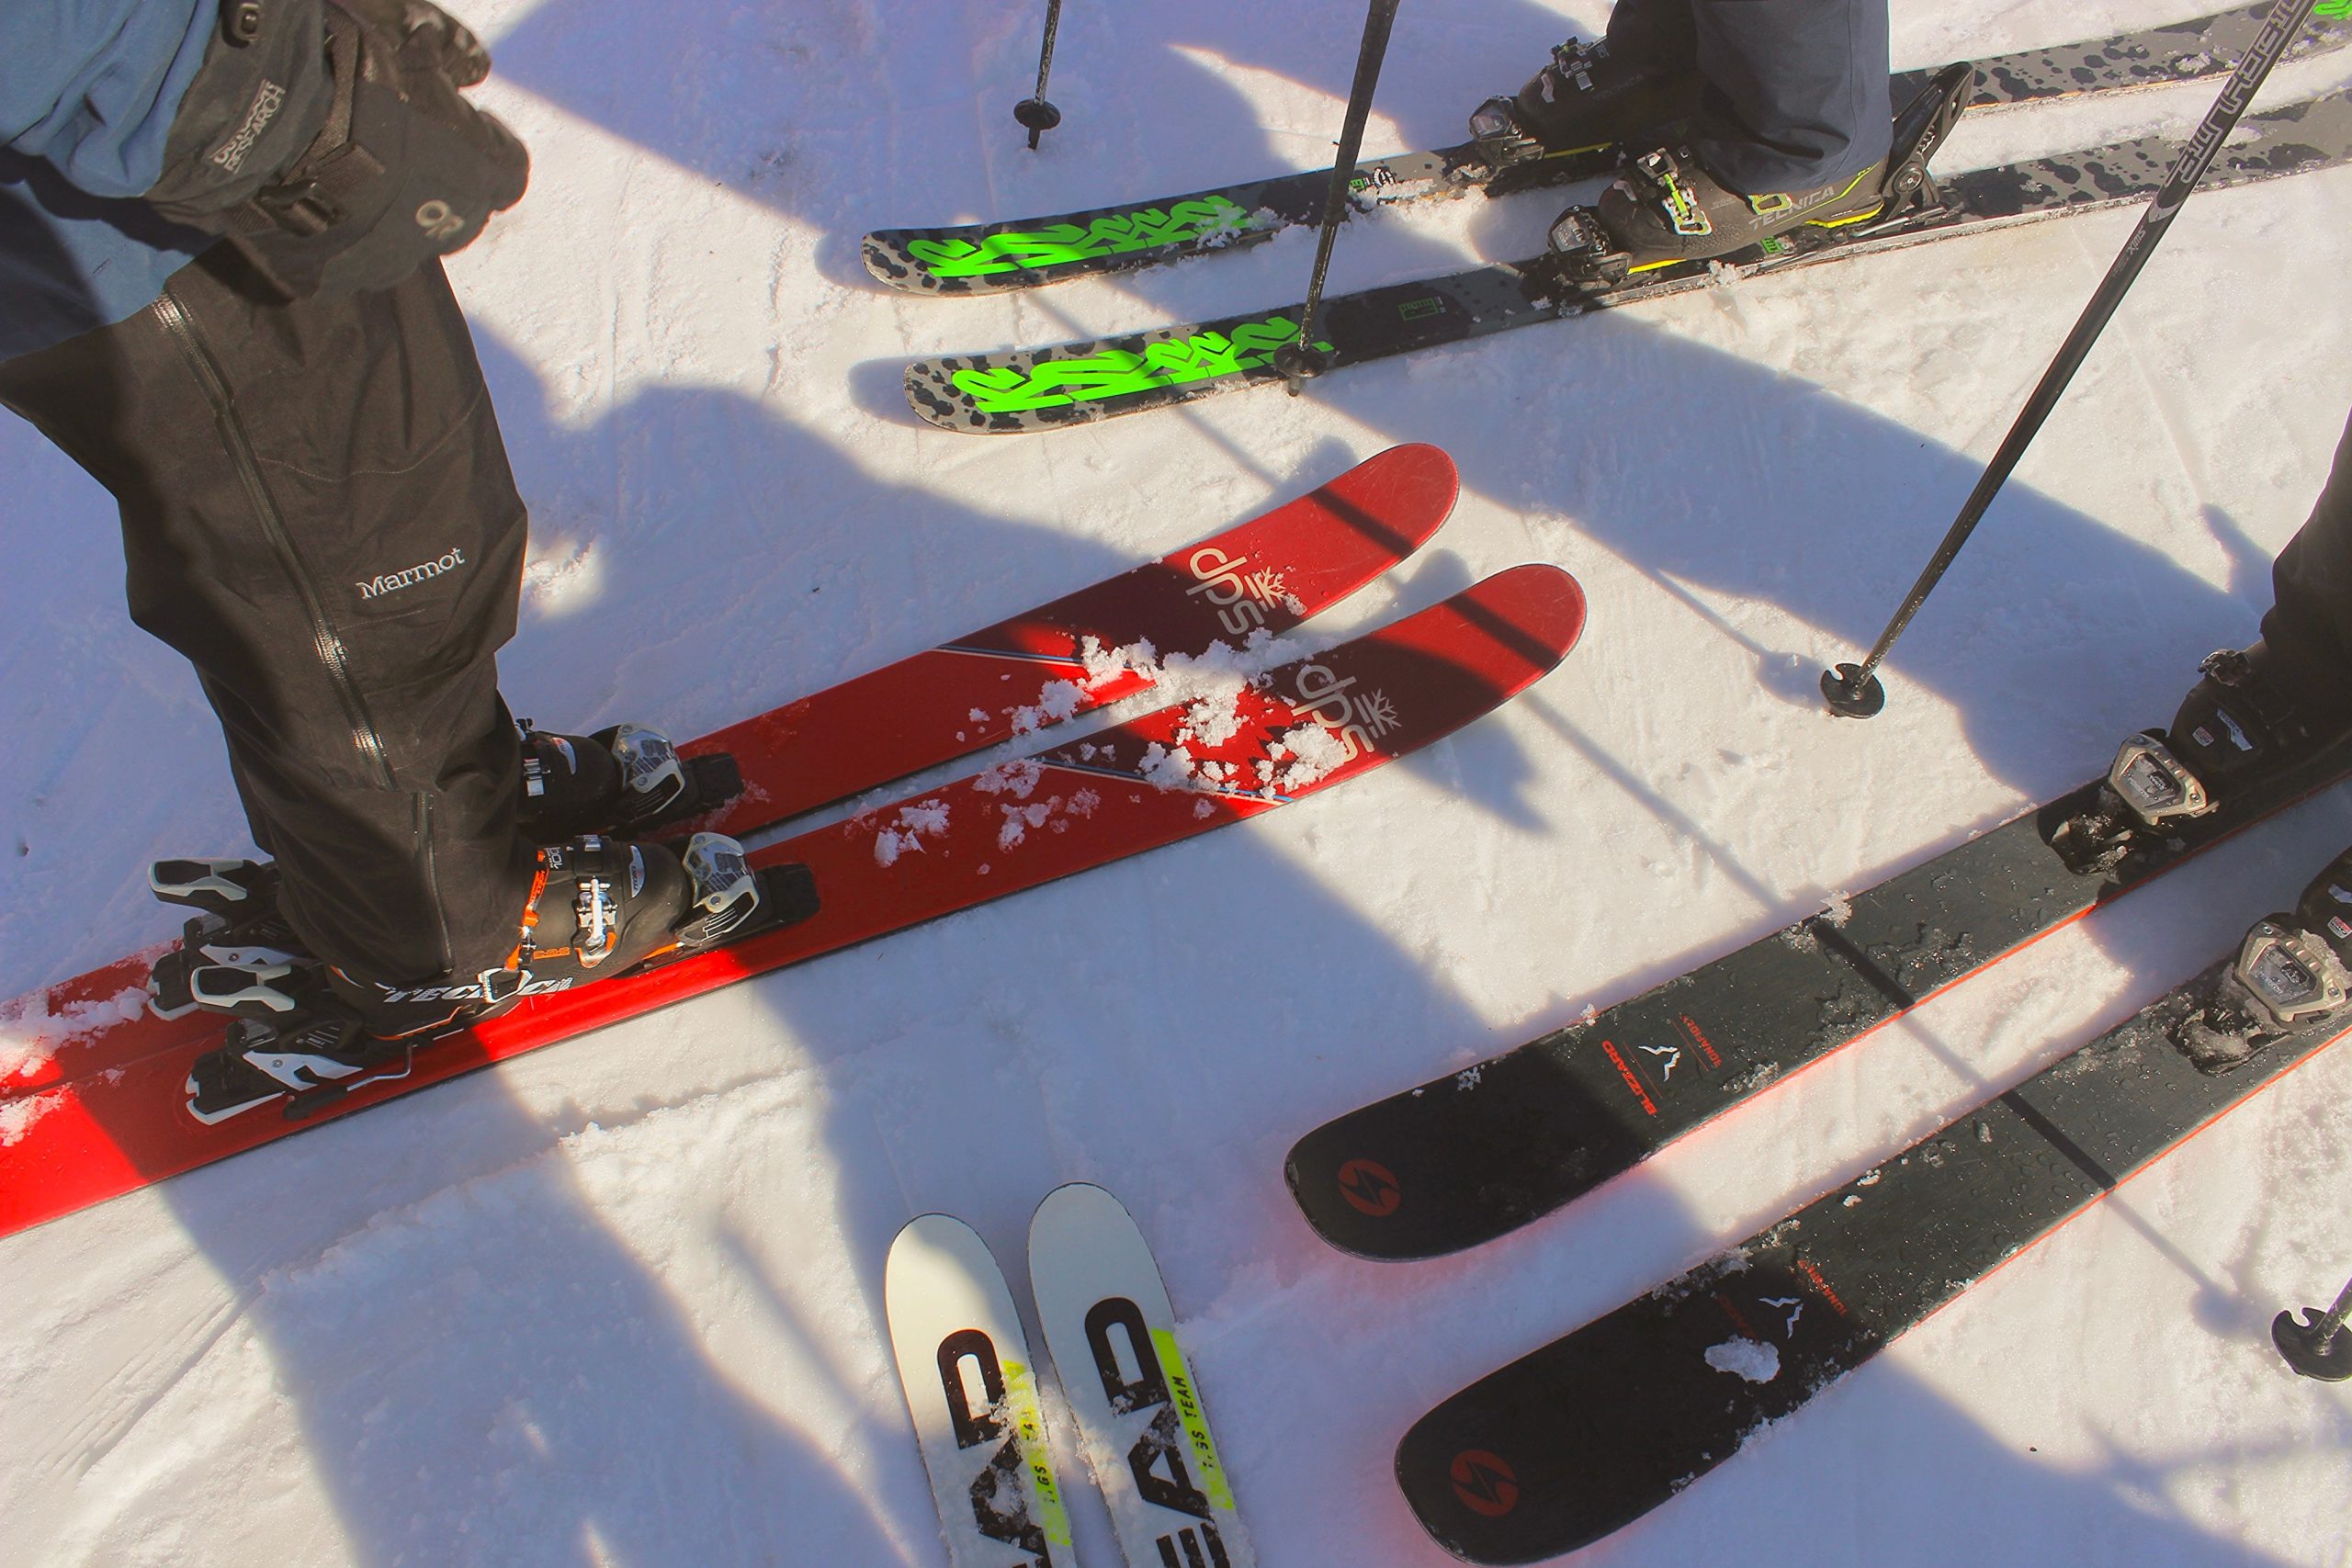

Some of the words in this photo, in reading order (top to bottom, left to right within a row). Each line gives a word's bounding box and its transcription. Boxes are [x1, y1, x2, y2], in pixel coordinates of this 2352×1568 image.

[355, 547, 466, 600] Marmot
[1186, 547, 1266, 635] dps
[1602, 1040, 1657, 1115] BLIZZARD
[1172, 1375, 1198, 1418] TEAM
